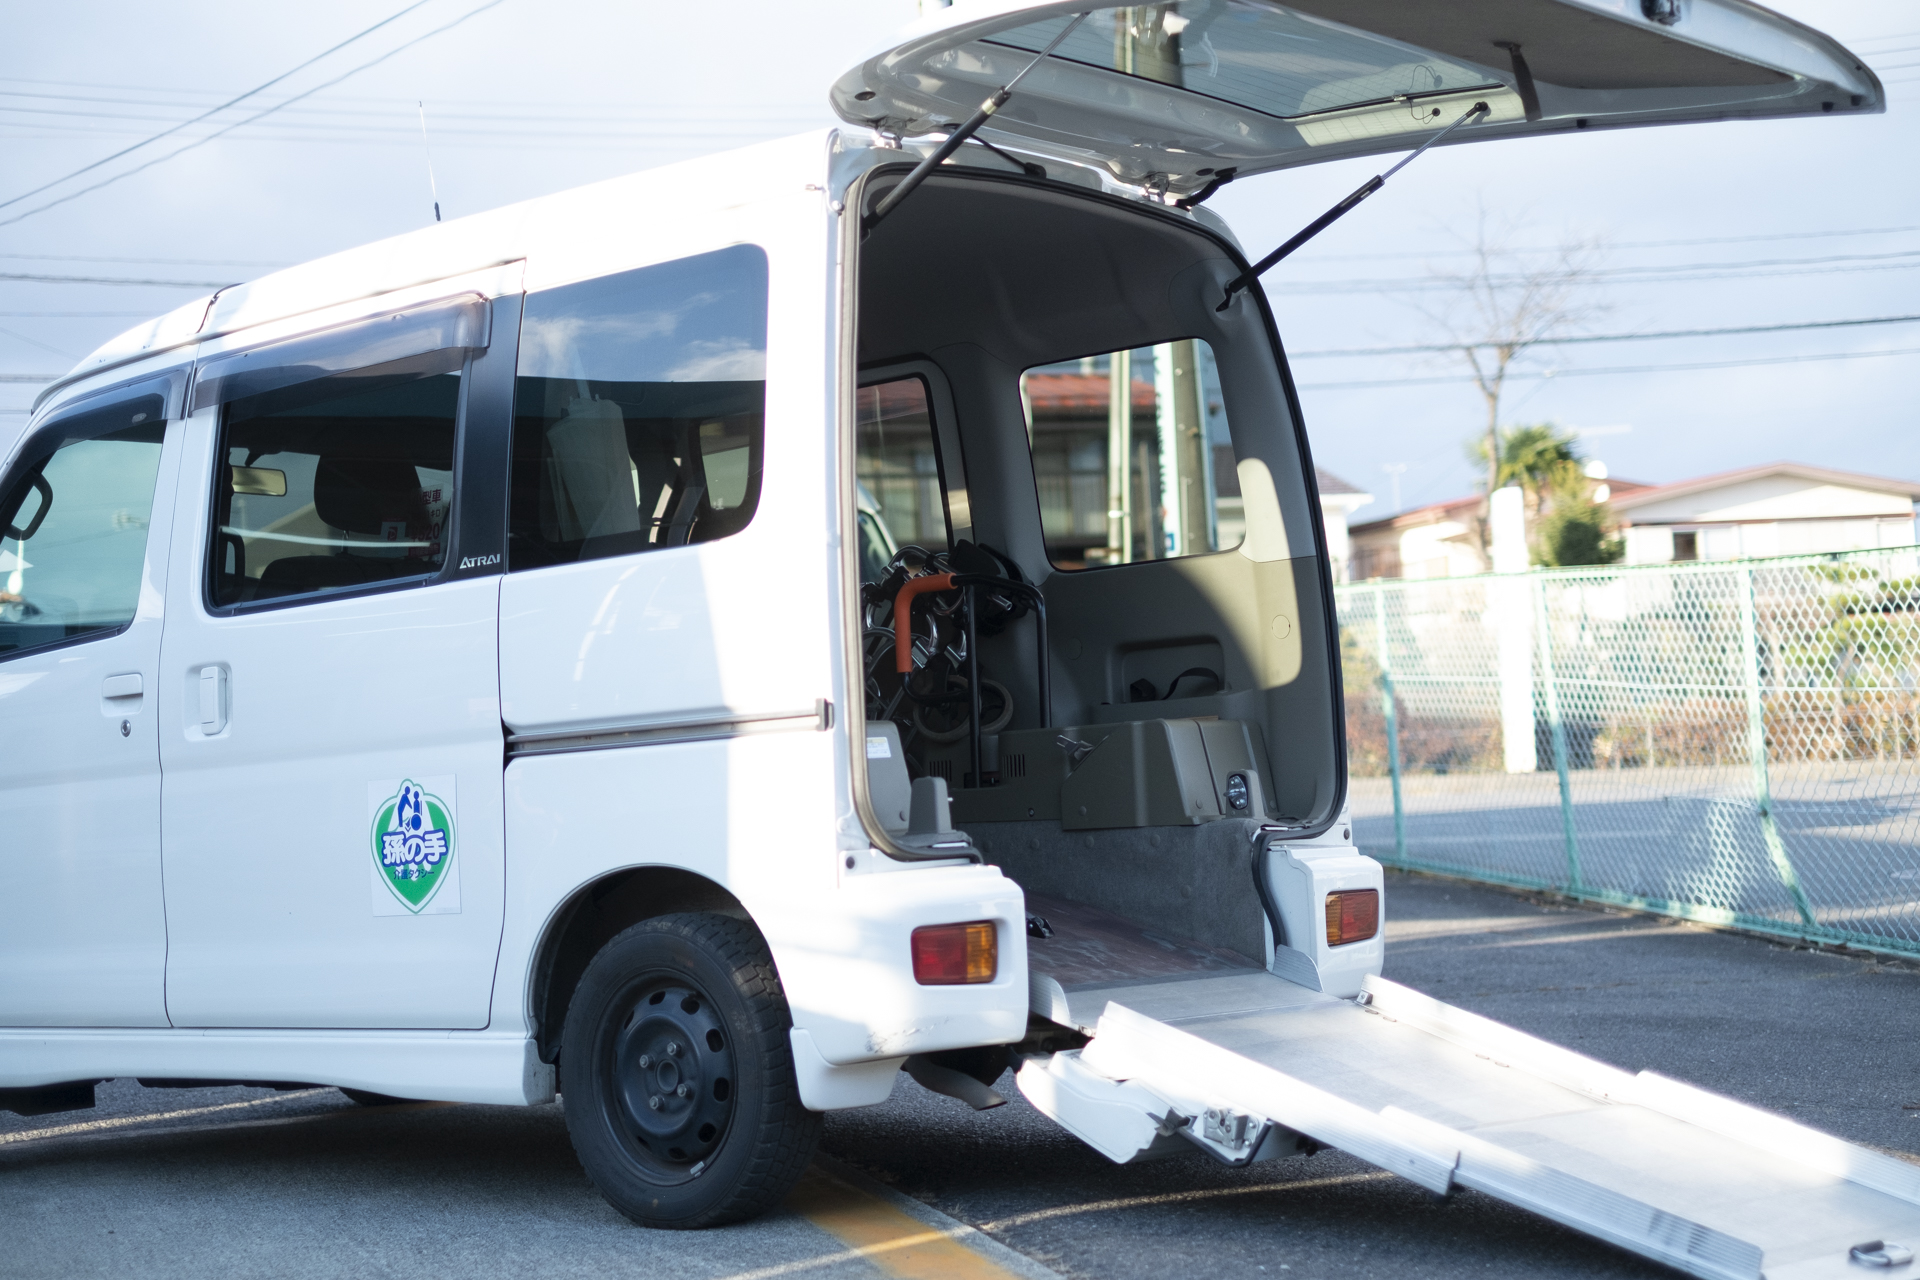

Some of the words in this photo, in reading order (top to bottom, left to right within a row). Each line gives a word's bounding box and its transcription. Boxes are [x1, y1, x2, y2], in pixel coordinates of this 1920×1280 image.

[459, 553, 501, 569] ATRAI
[382, 829, 448, 867] 孫の手
